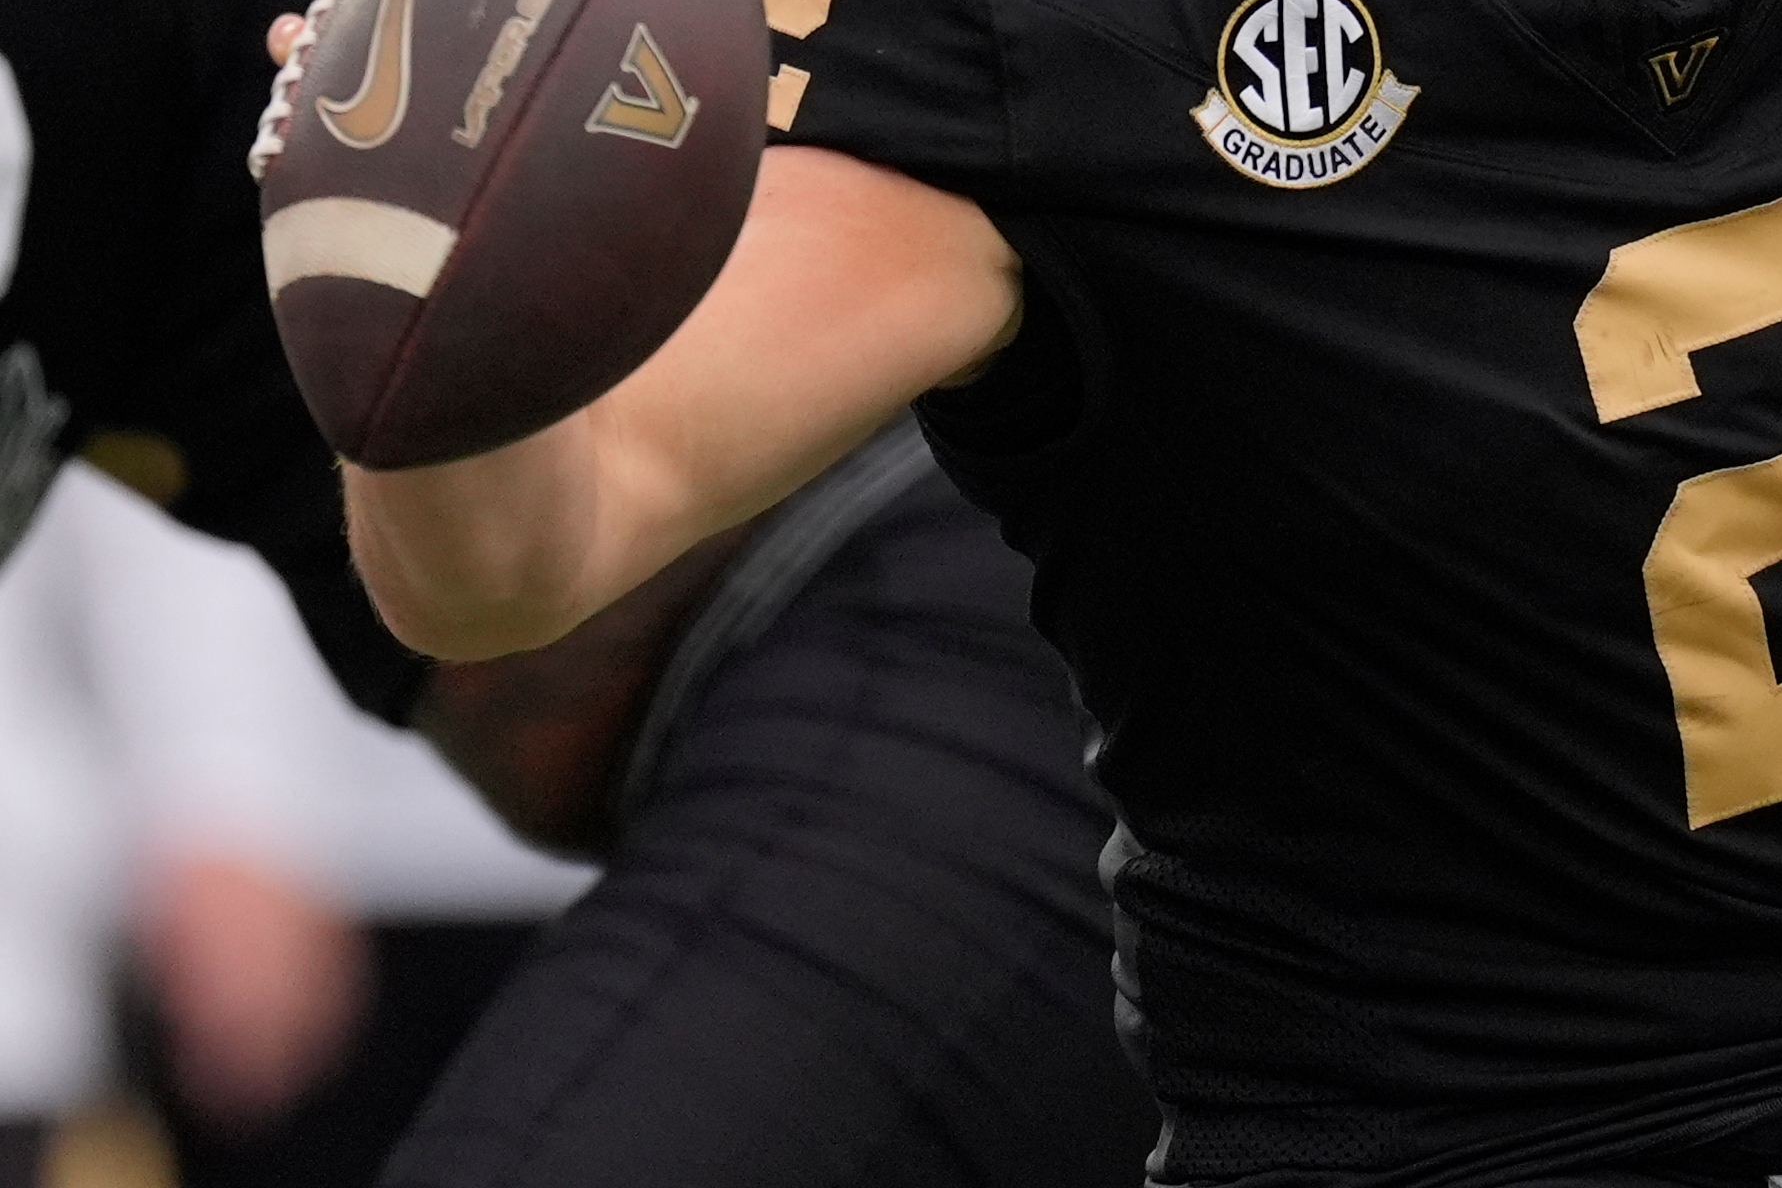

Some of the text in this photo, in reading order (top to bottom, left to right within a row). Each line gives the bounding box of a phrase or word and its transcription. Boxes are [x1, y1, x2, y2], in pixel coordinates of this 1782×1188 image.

[584, 20, 700, 149] V
[1648, 35, 1720, 106] V
[1222, 114, 1387, 182] GRADUATE
